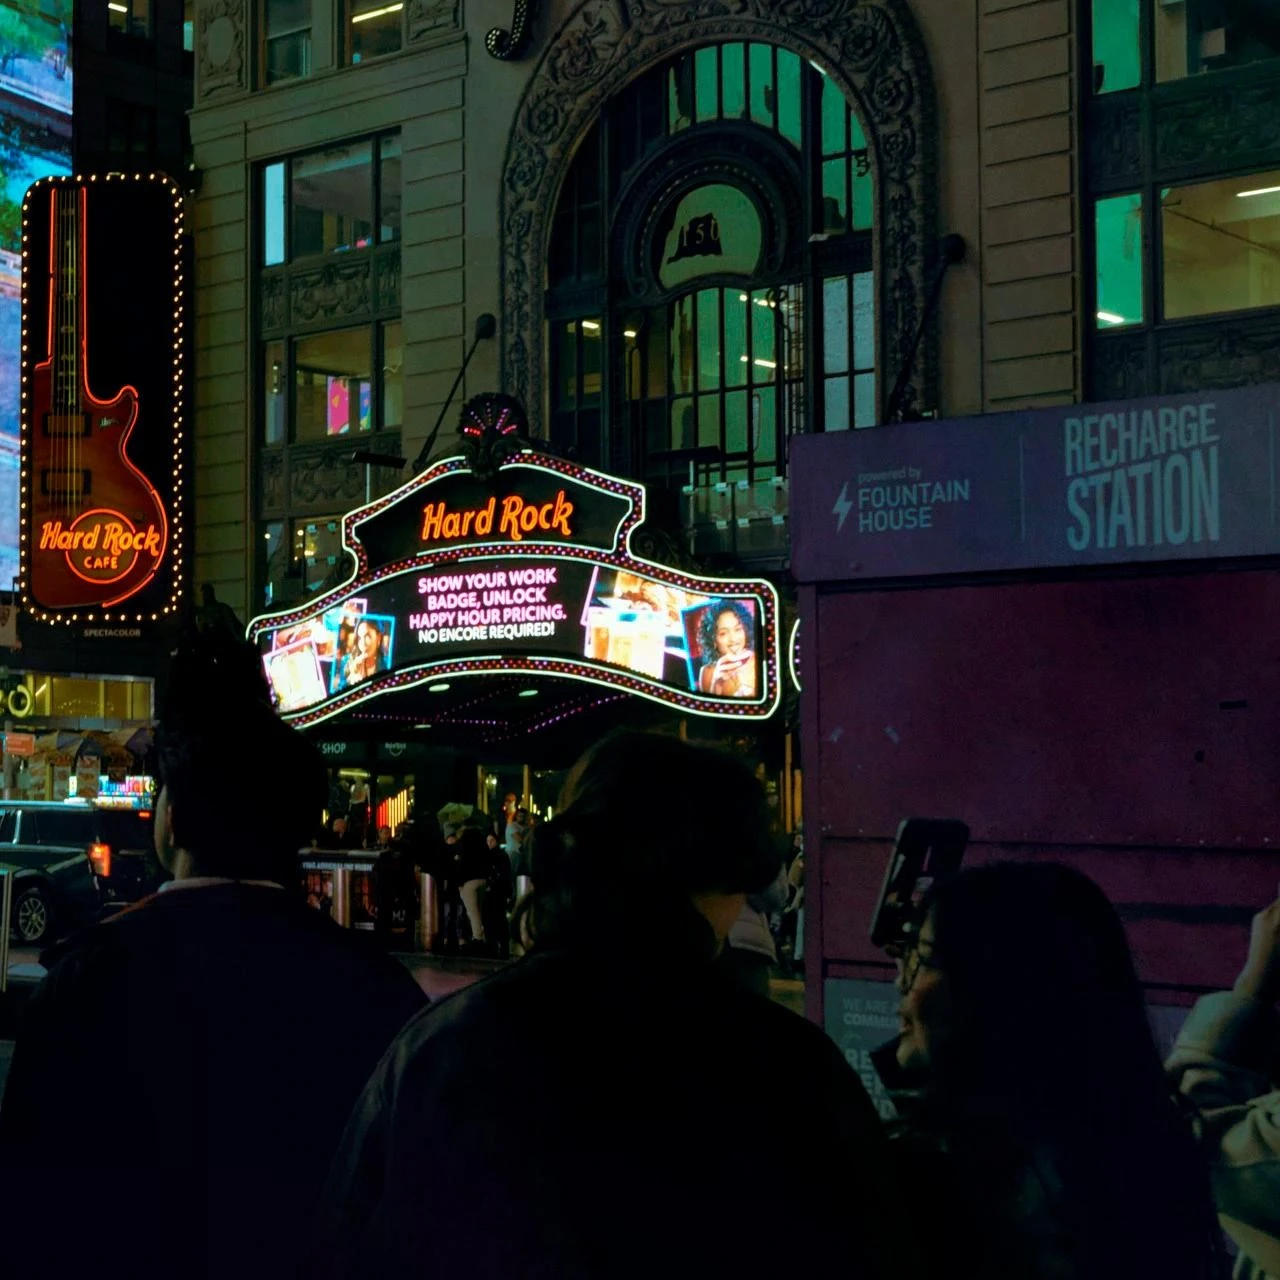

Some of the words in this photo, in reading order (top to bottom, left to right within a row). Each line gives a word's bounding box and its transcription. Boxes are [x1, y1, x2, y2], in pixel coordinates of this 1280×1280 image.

[1064, 402, 1221, 477] RECHARGE
[857, 466, 905, 484] powered
[908, 463, 922, 480] by
[857, 478, 970, 510] FOUNTAIN
[1066, 444, 1220, 552] STATION
[421, 496, 496, 541] Hard
[499, 489, 574, 542] Rock
[857, 505, 933, 533] HOUSE
[39, 520, 101, 551] Hard
[102, 520, 161, 557] Rock
[83, 555, 119, 570] CAFE
[418, 575, 464, 594] SHOW
[465, 572, 507, 590] YOUR
[509, 567, 557, 586] WORK
[428, 592, 481, 610] BADGE,
[483, 587, 547, 606] UNLOCK
[409, 611, 456, 630] HAPPY
[458, 608, 500, 626] HOUR
[503, 604, 567, 623] PRICING.
[83, 628, 141, 638] SPECTACOLOR
[418, 629, 439, 644] NO
[439, 625, 488, 642] ENCORE
[489, 621, 555, 640] REQUIRED!
[321, 742, 347, 755] SHOP
